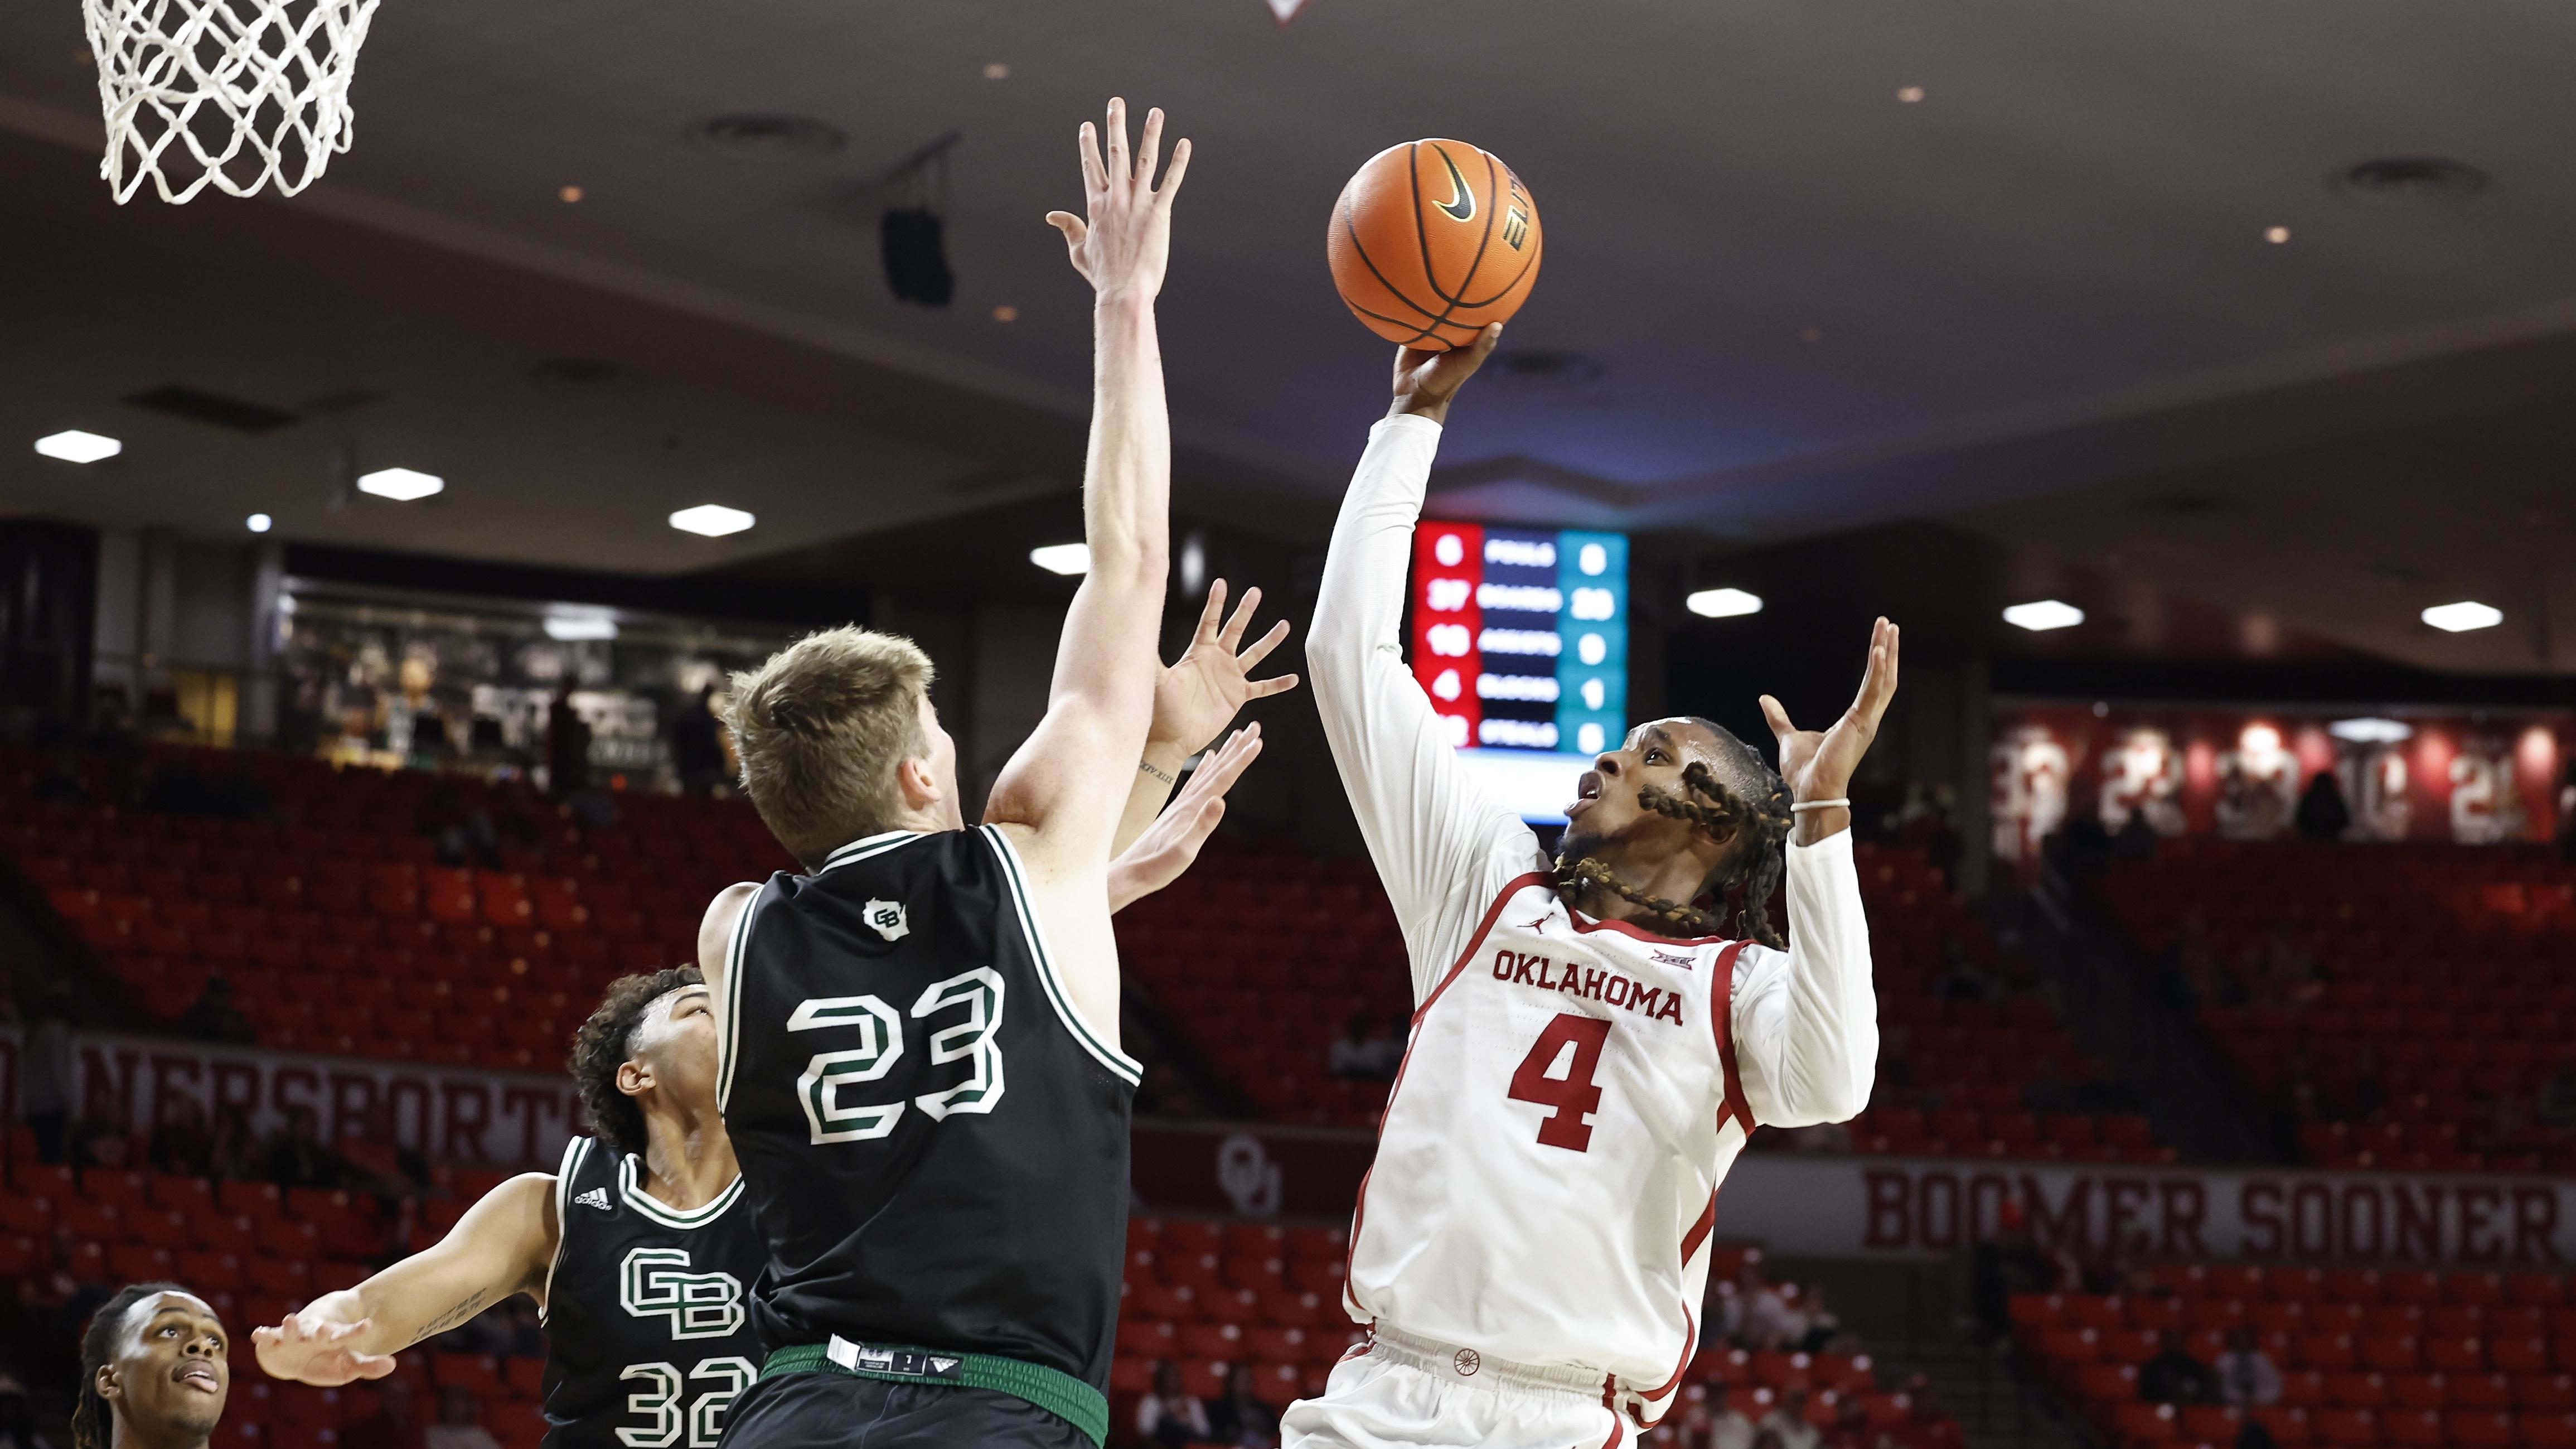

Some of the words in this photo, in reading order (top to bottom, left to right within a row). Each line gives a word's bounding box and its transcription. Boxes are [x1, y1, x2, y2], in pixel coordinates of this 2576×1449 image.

[1503, 174, 1529, 252] ELIT
[874, 908, 900, 929] GB
[1493, 949, 1683, 1027] OKLAHOMA
[787, 965, 1006, 1145] 23
[1507, 1012, 1613, 1153] 4
[574, 1195, 612, 1211] adidas
[1863, 1171, 2209, 1258] BOOMER
[2240, 1181, 2566, 1263] SOONER
[620, 1248, 745, 1341] GB
[614, 1356, 758, 1449] 32
